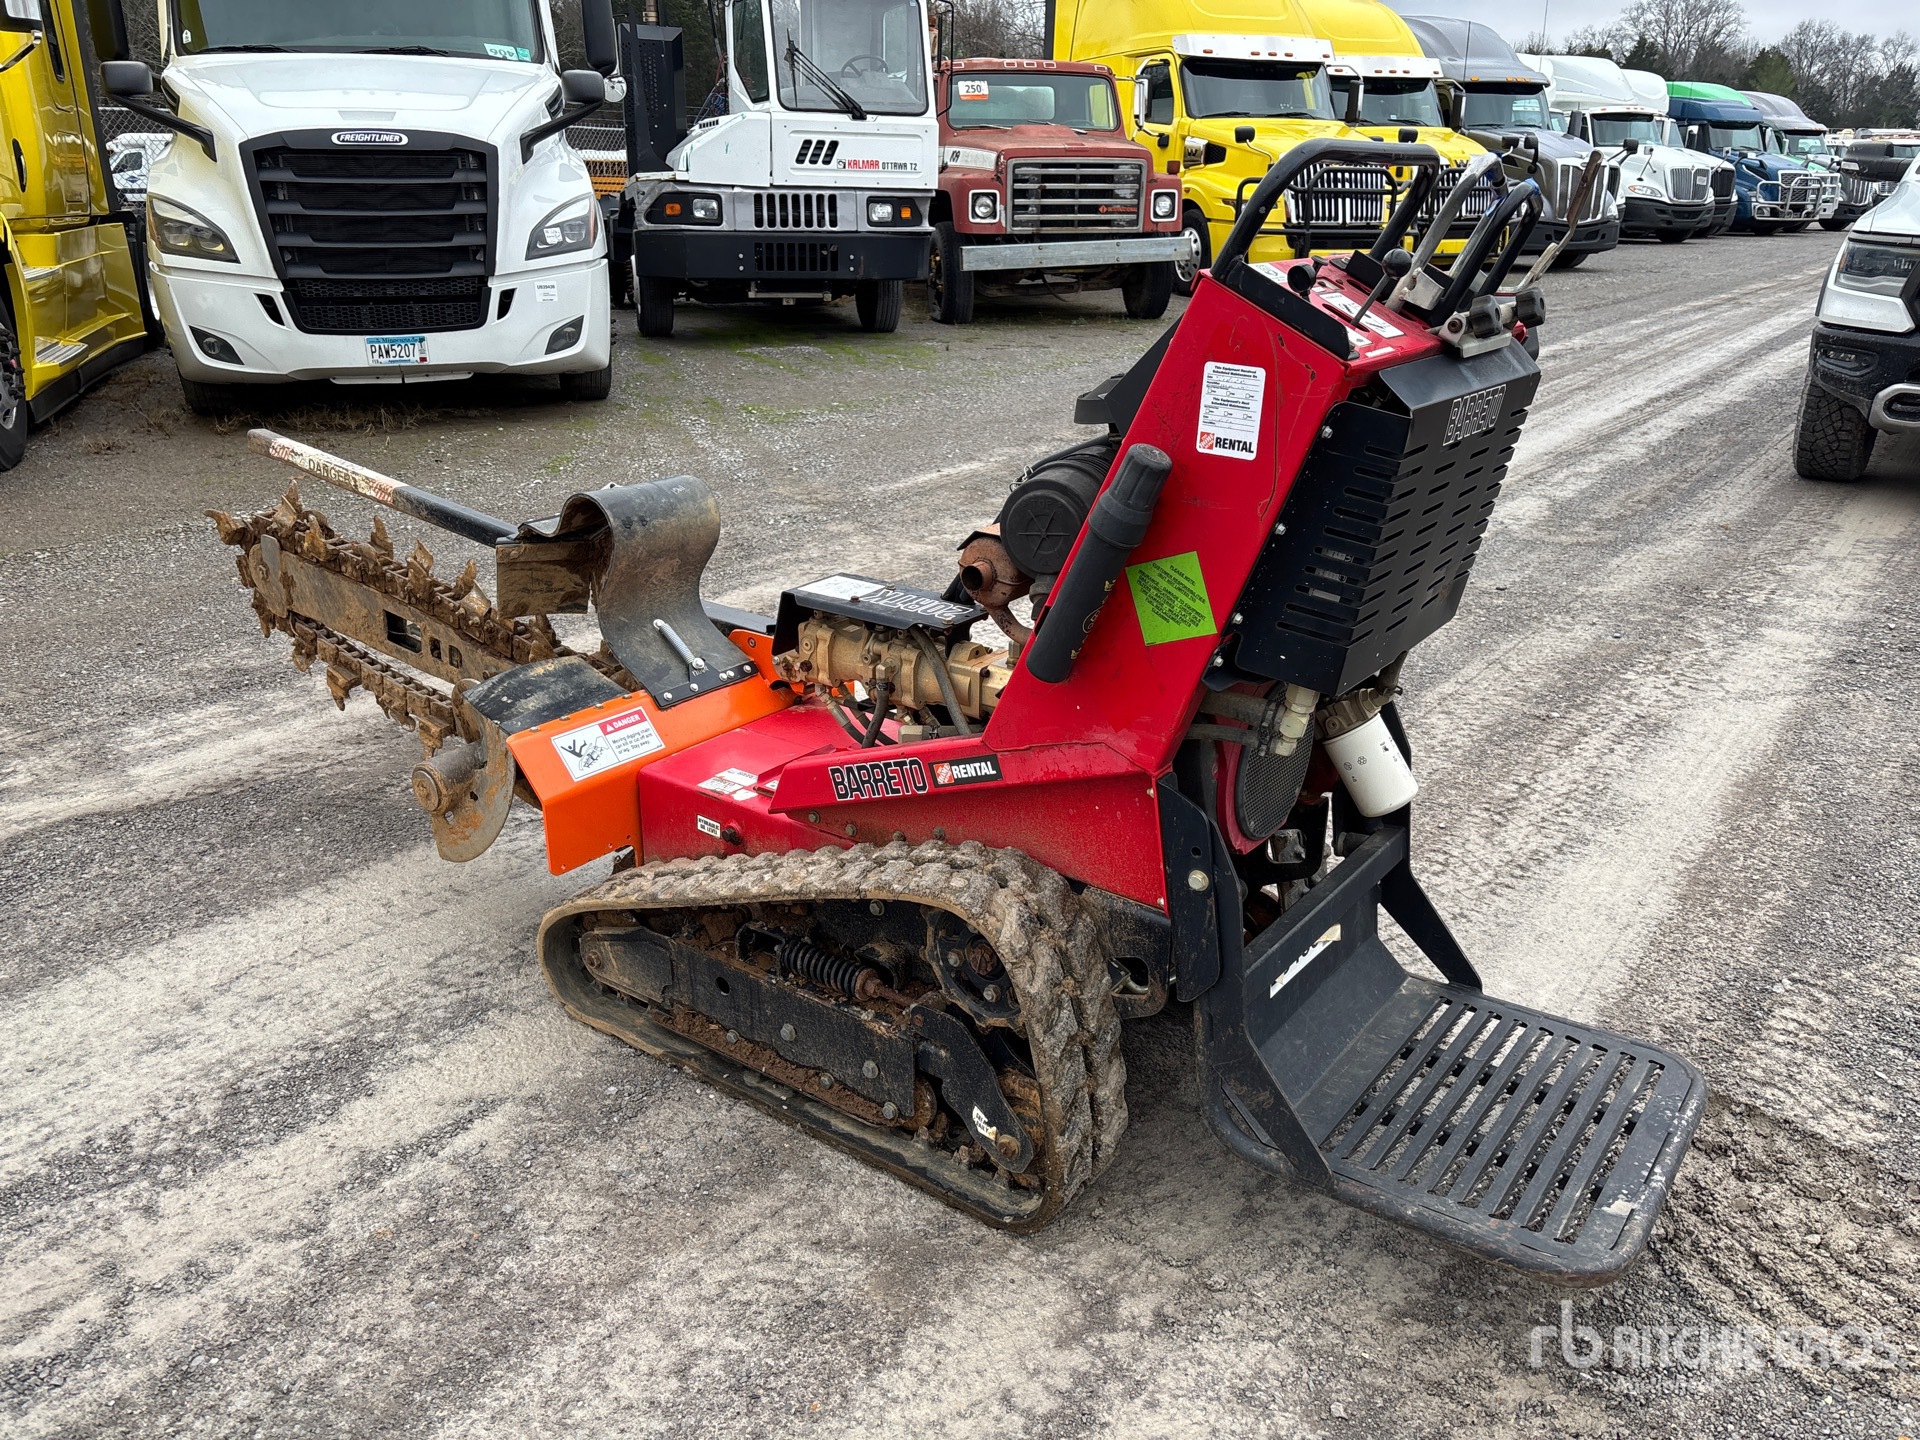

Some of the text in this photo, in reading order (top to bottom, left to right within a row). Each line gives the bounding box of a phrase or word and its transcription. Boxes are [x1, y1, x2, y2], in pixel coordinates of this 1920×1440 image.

[965, 84, 982, 93] 250
[340, 134, 400, 142] FREIGHTLINER
[1187, 148, 1198, 156] W
[848, 160, 918, 170] KALMAR OTTAWA T2
[370, 343, 416, 359] PAW5207
[1443, 384, 1506, 446] BARRETO
[1215, 437, 1254, 454] RENTAL
[862, 589, 974, 620] 20RTK
[612, 714, 640, 729] DANGER
[952, 761, 996, 780] RENTAL
[828, 757, 928, 801] BARRETO
